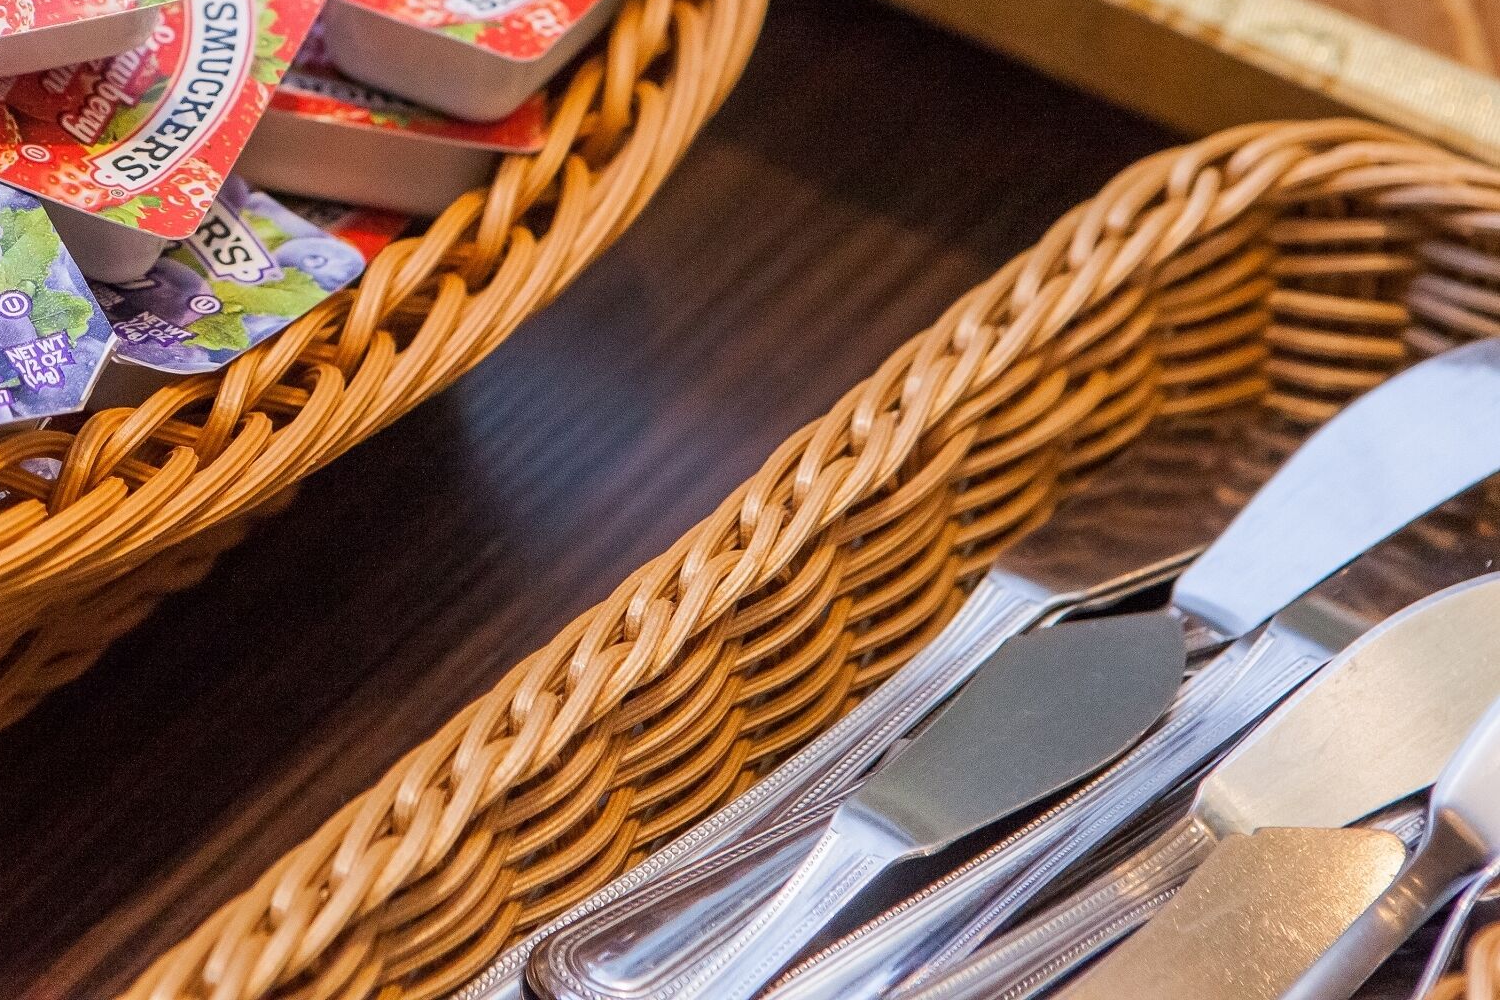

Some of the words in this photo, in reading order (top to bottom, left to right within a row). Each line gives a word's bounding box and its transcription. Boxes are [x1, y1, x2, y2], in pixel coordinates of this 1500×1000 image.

[113, 1, 237, 182] SMUCKER'S
[148, 329, 174, 342] OZ
[164, 325, 192, 339] WT
[6, 341, 37, 363] NET
[39, 334, 67, 352] WT
[16, 358, 41, 376] 1/2
[42, 350, 69, 367] OZ
[23, 366, 61, 389] (14g)
